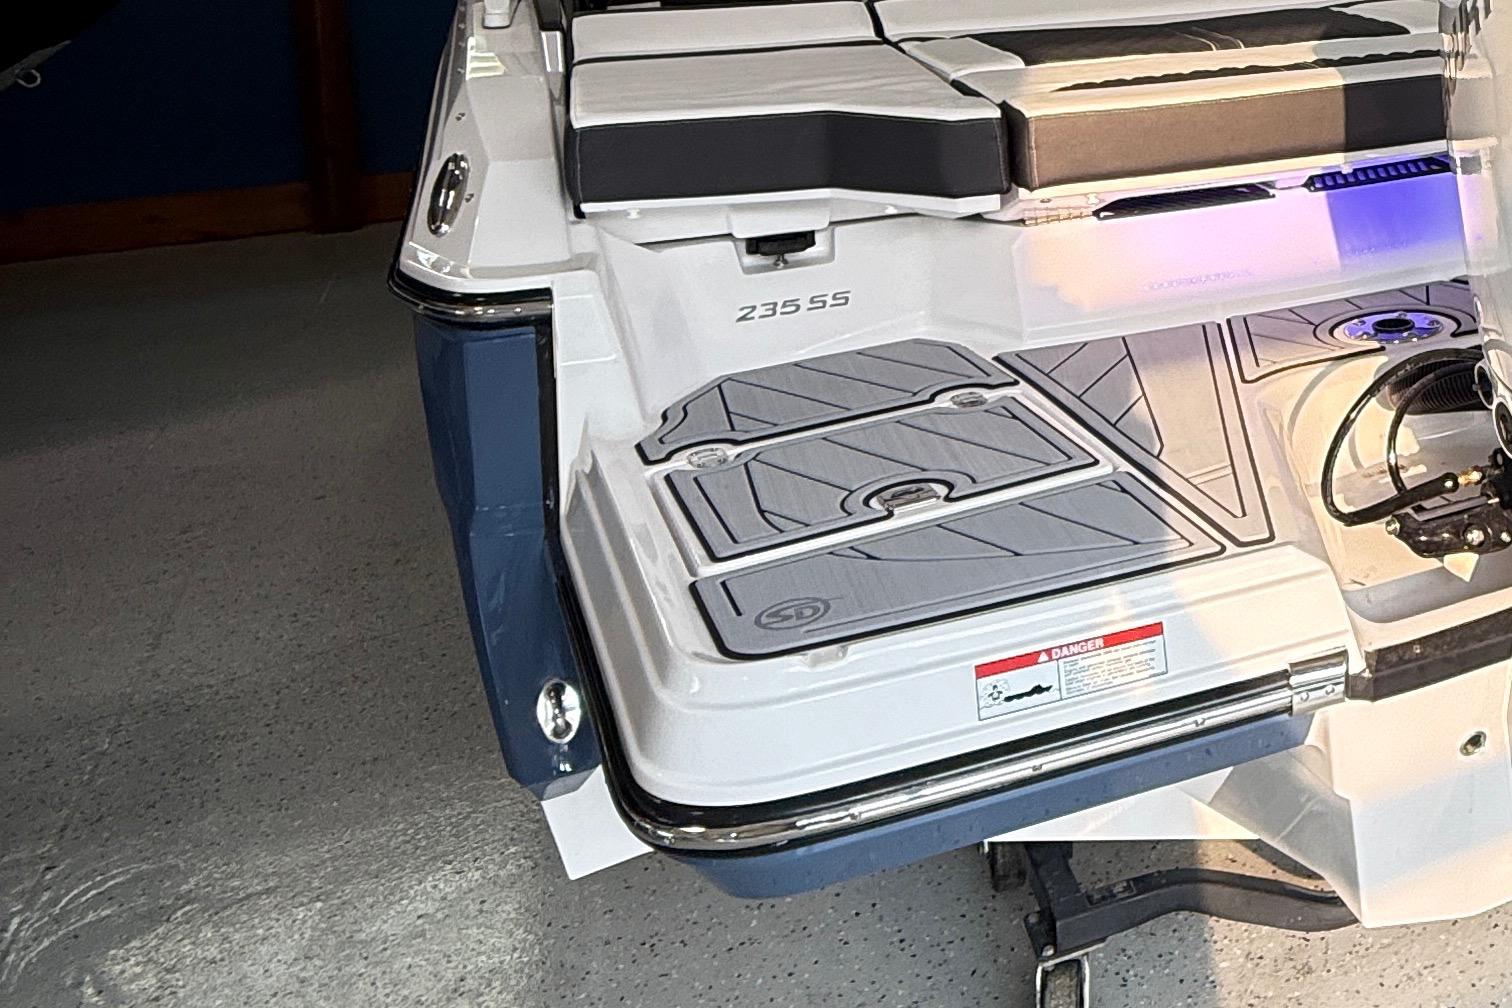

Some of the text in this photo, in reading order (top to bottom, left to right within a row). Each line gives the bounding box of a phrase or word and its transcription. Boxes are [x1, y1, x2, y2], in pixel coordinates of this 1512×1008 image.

[736, 290, 851, 323] 235 SS
[1051, 639, 1104, 659] DANGER
